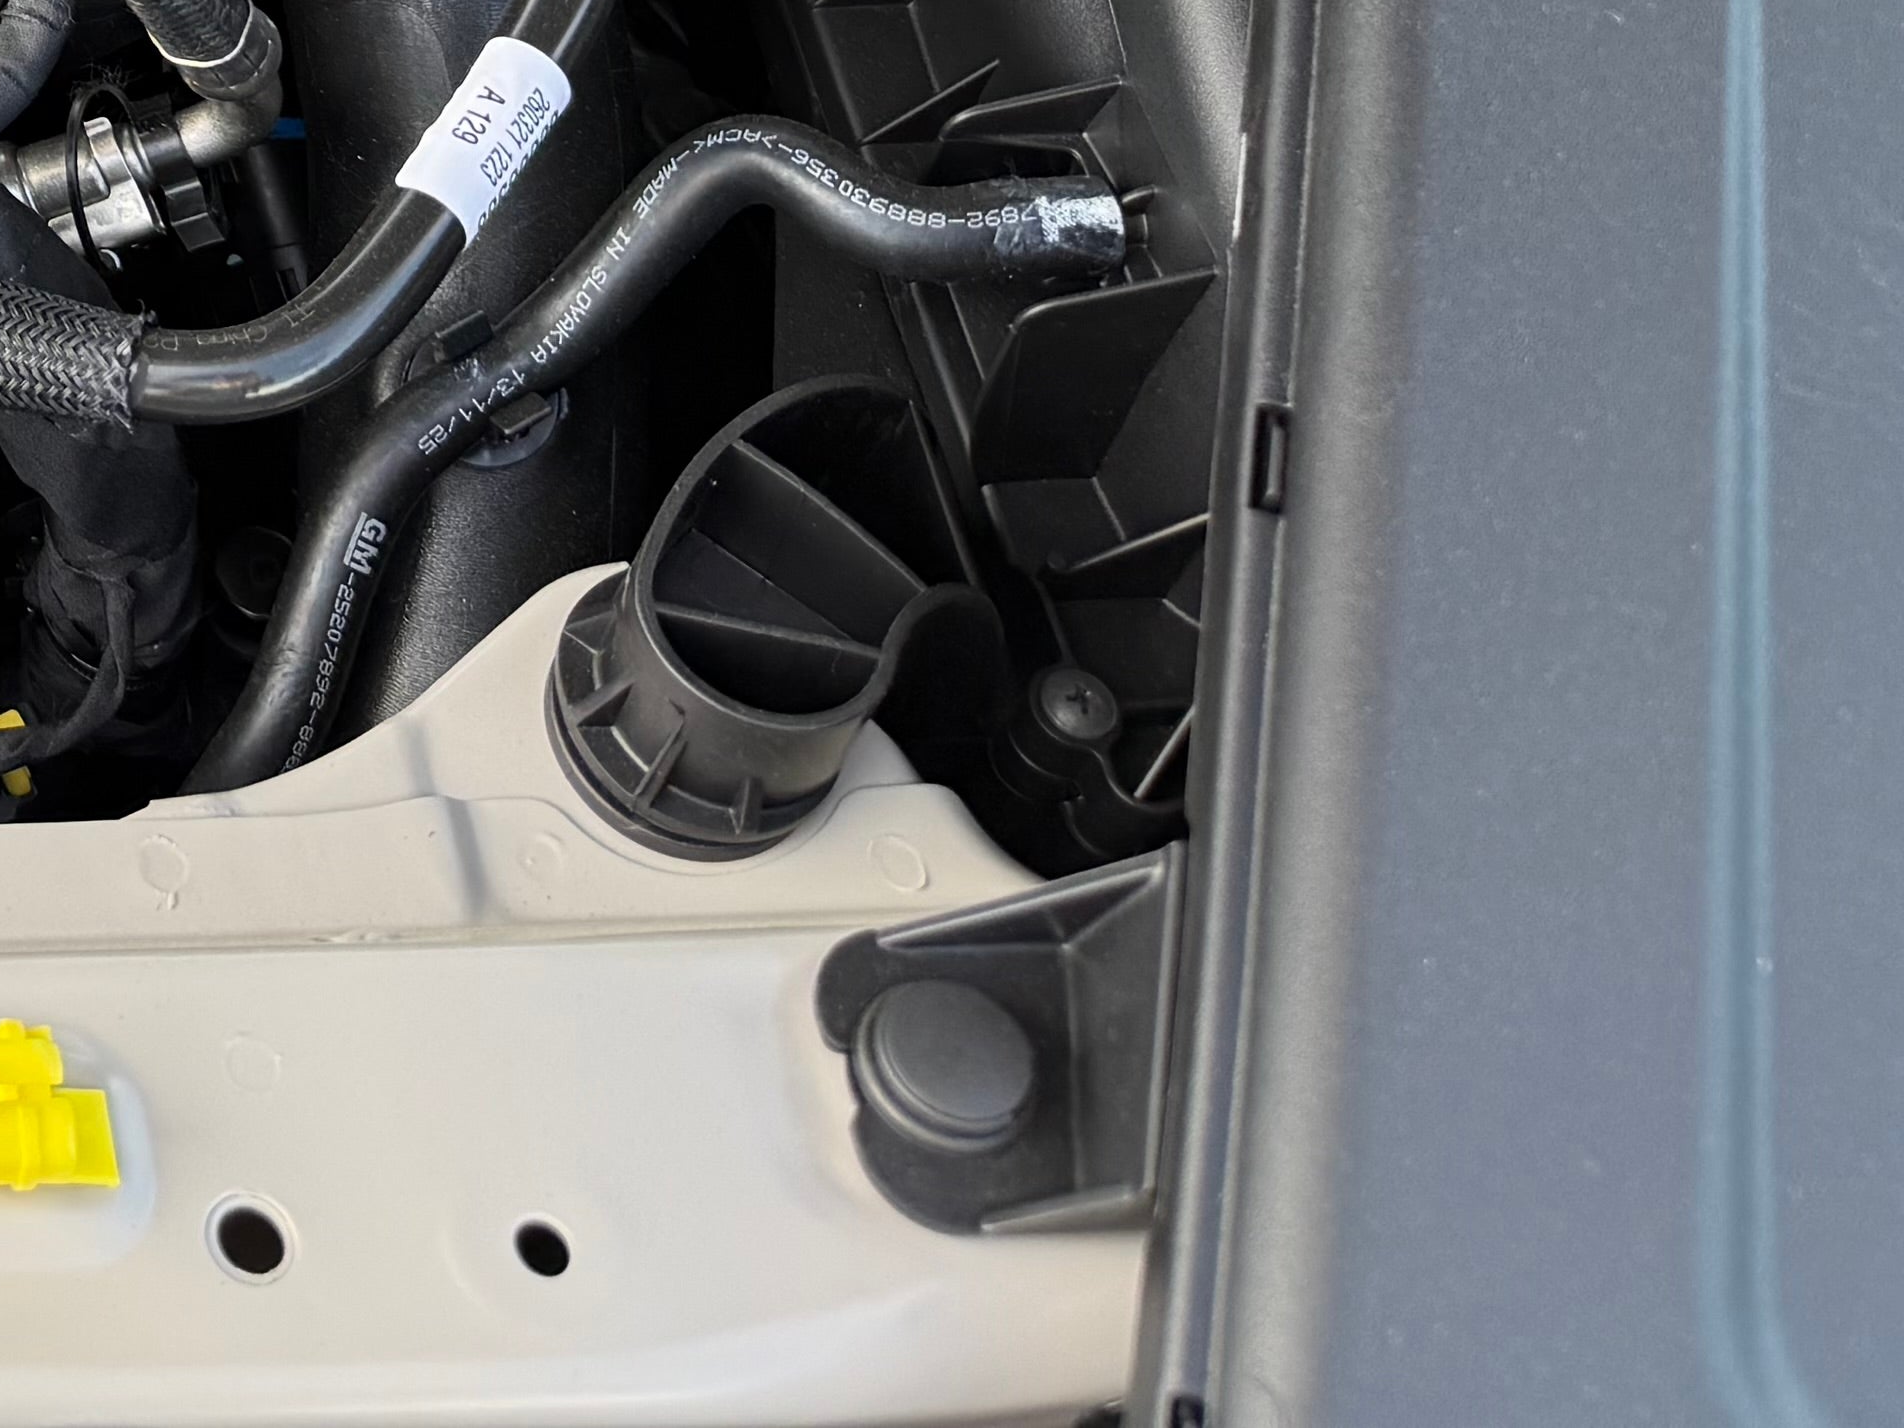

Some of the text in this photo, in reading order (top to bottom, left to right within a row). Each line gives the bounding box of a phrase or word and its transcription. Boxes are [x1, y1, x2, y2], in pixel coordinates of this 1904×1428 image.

[451, 85, 506, 145] A 129
[480, 141, 513, 187] 1223
[606, 226, 632, 260] IN
[530, 264, 607, 364] SLOVAKIA
